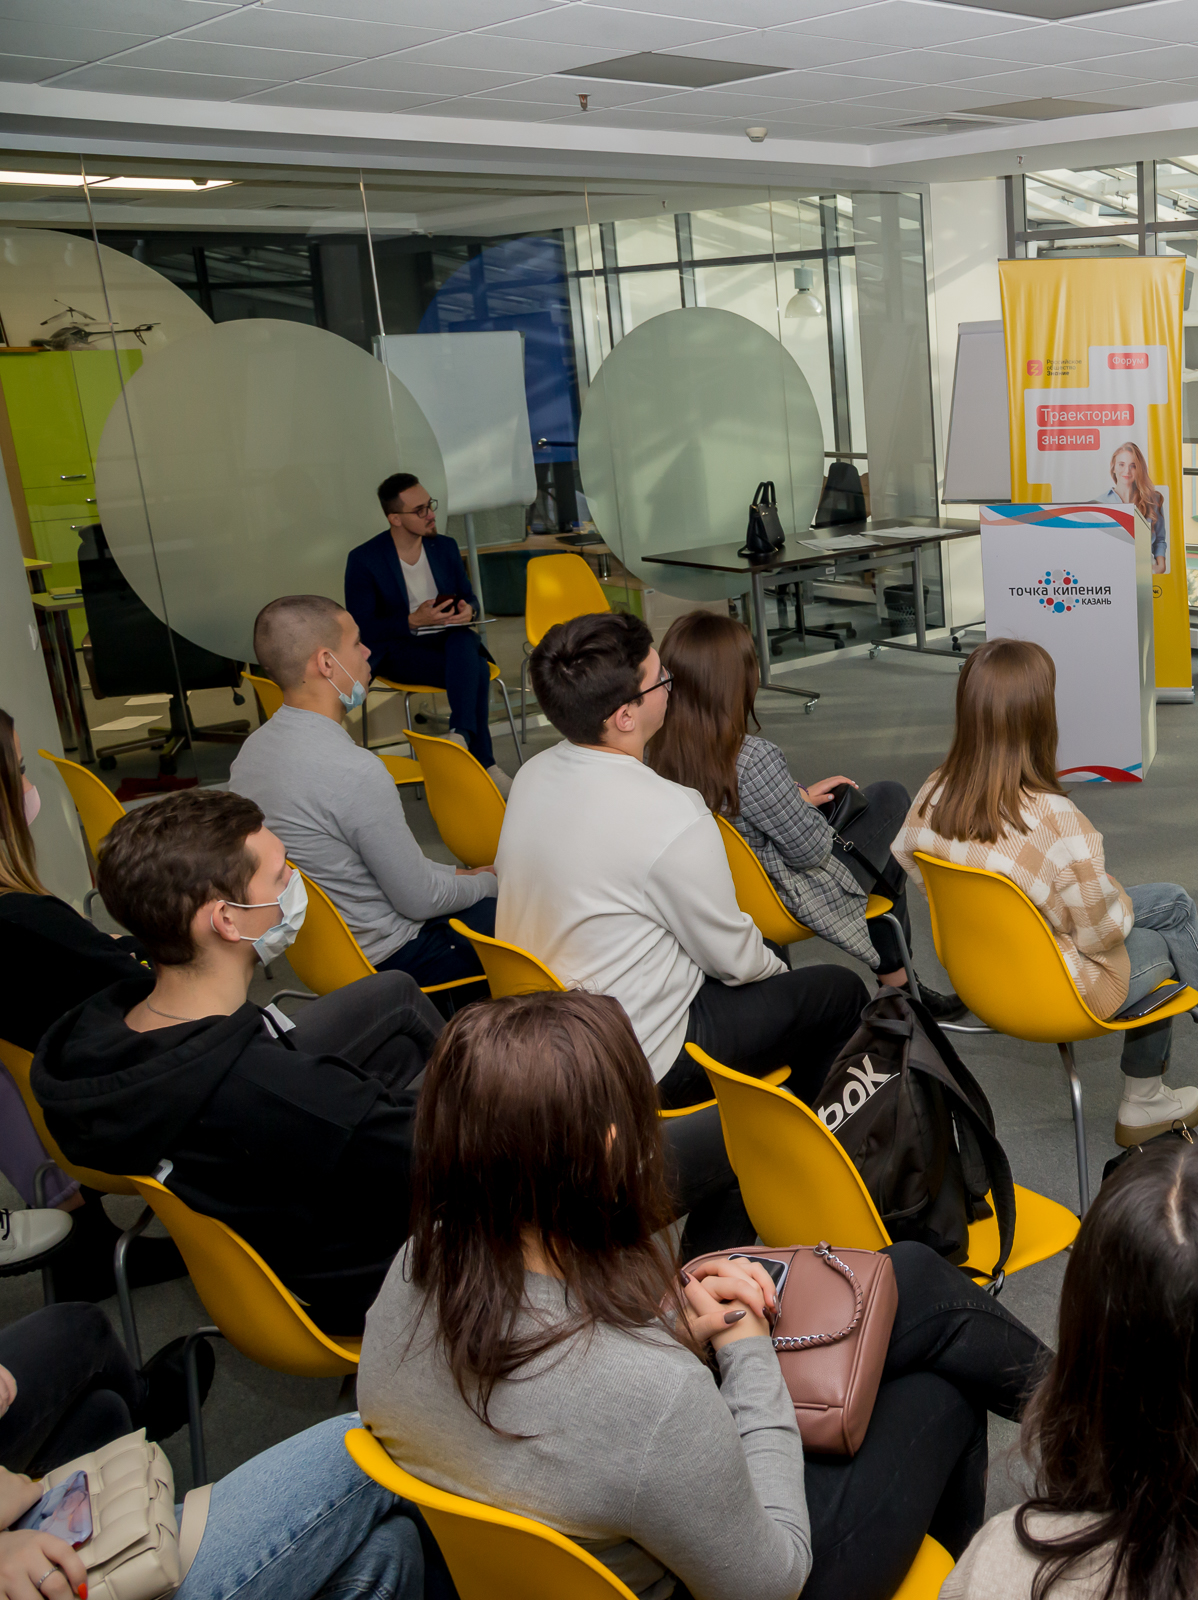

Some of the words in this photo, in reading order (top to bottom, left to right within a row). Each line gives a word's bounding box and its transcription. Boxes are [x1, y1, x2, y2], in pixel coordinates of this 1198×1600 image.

[1112, 356, 1144, 366] Форум
[1041, 408, 1130, 424] Траектория
[1041, 435, 1095, 445] знания
[1009, 587, 1048, 596] точка
[1053, 586, 1112, 596] кипения
